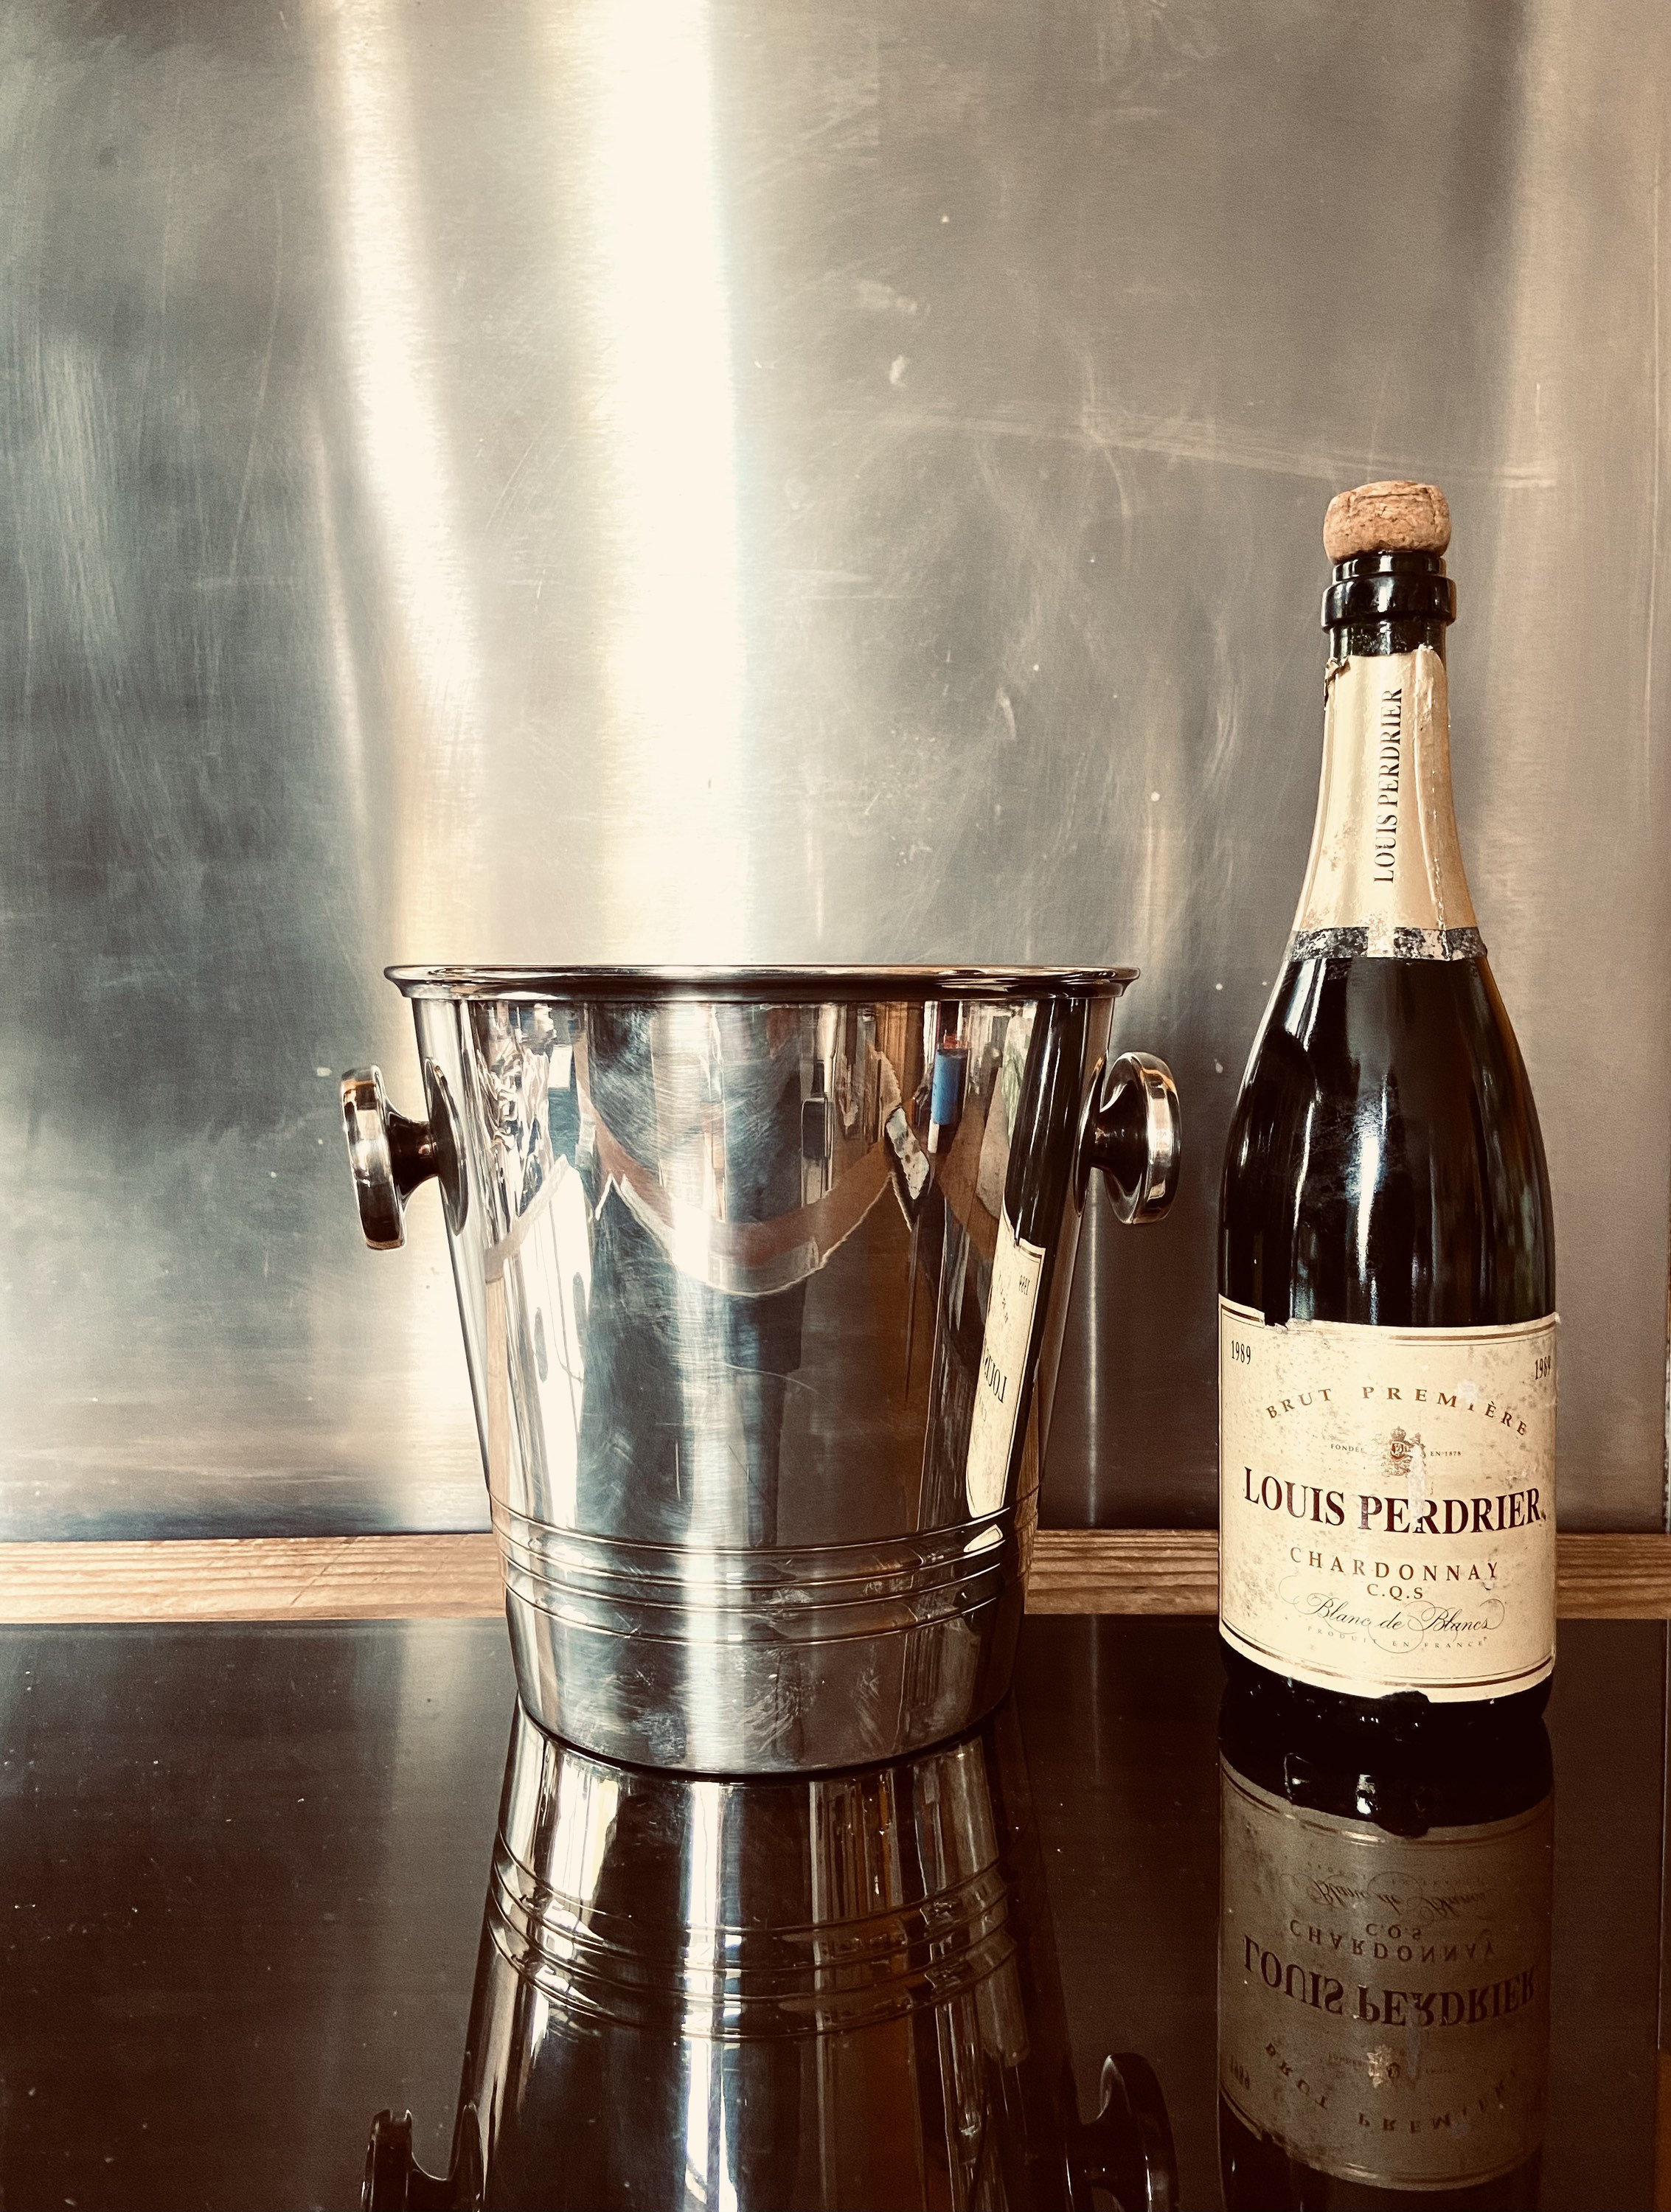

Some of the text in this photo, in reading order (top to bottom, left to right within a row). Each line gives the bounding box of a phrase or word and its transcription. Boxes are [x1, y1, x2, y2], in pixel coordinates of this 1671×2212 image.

[1373, 688, 1403, 884] LOUIS PERDRIER
[1230, 1339, 1252, 1366] 1989
[1265, 1387, 1333, 1420] BRUT
[1243, 1466, 1542, 1534] LOUIS PERDRIER
[1290, 1546, 1498, 1582] CHARDONNAY
[1366, 1583, 1424, 1601] C.Q.S
[1294, 1591, 1497, 1632] Blanc de Blancs
[1307, 1625, 1484, 1649] PRODUIT EN FRANCE
